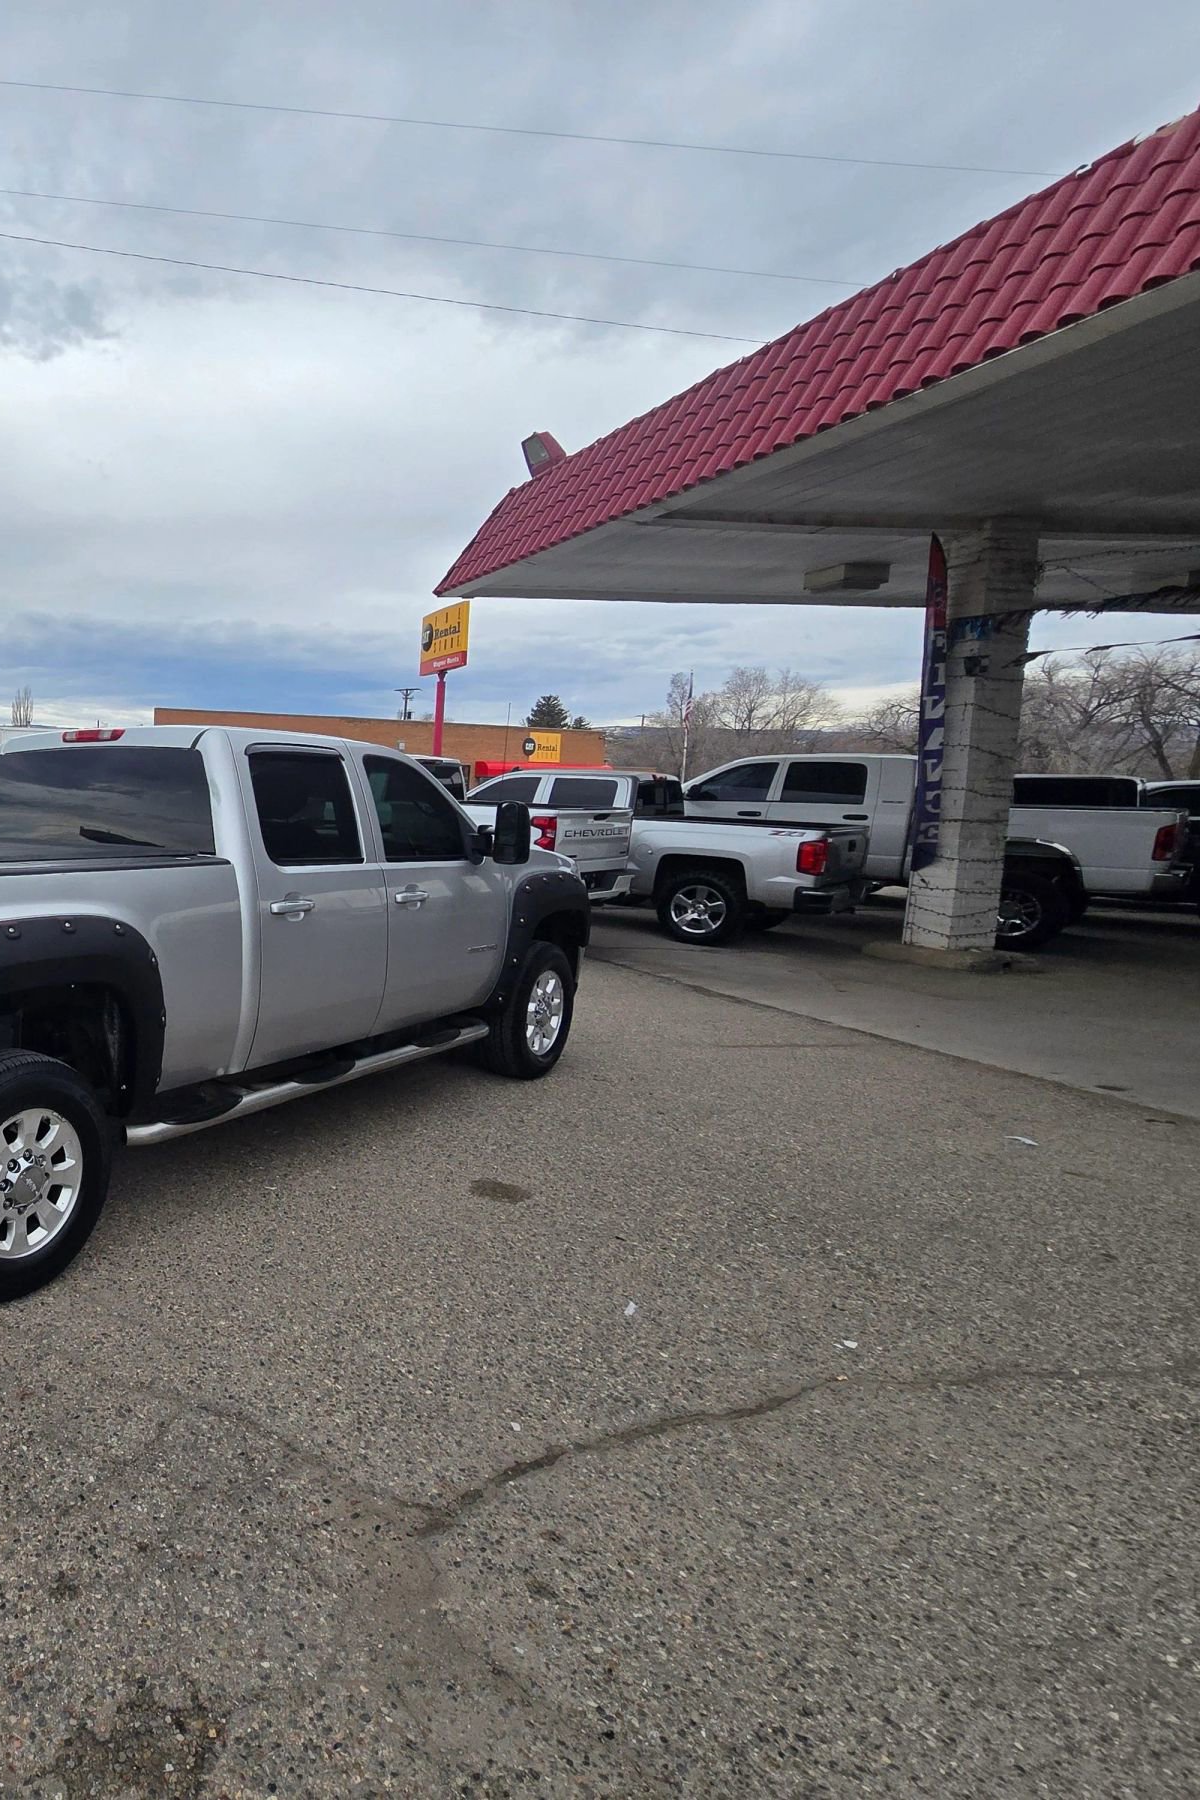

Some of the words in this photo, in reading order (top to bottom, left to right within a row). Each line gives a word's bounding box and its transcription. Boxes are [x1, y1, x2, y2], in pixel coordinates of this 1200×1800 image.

[434, 621, 461, 640] Rental
[537, 743, 558, 752] Rental
[564, 827, 628, 838] CHEVROLET
